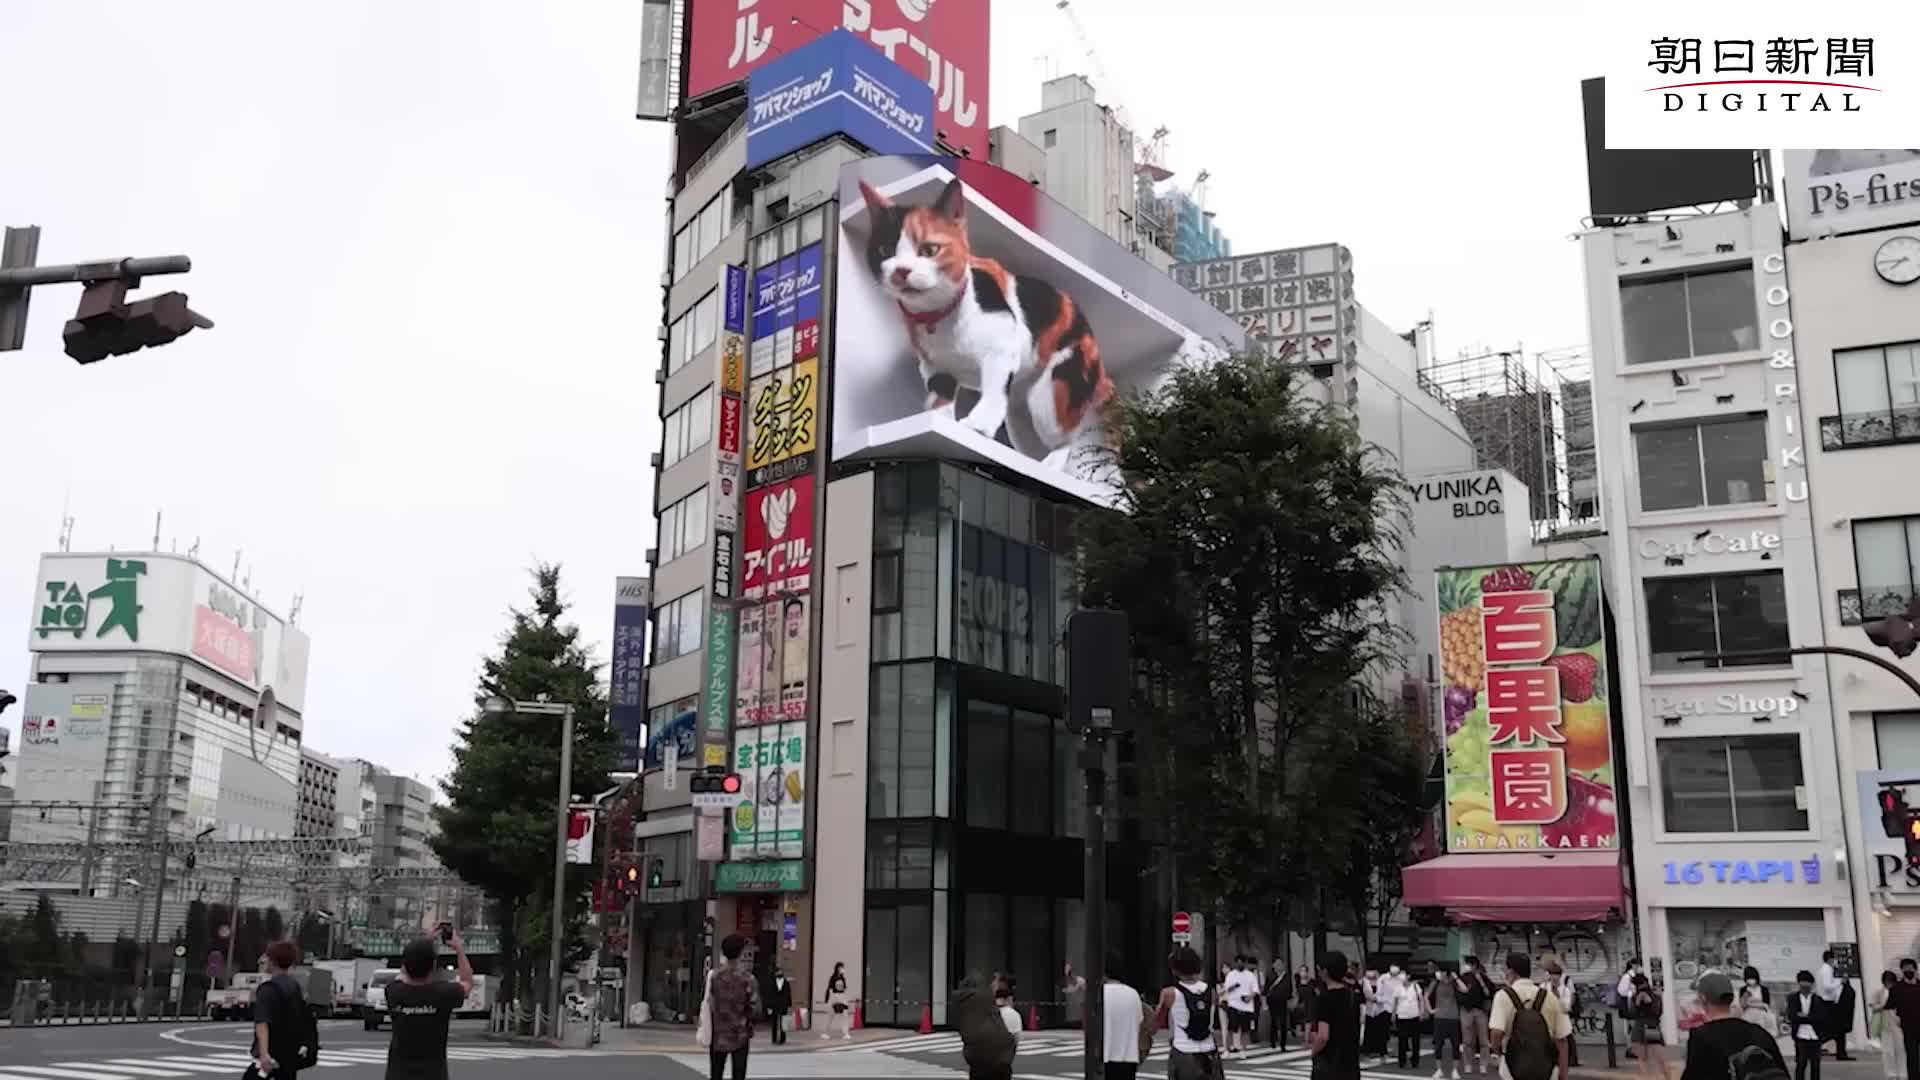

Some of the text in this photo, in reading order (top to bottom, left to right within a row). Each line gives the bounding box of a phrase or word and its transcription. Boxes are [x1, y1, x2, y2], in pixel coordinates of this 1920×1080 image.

[1409, 476, 1502, 503] YUNIKA
[1639, 530, 1782, 560] Cat Cafe
[1480, 589, 1569, 825] 百果園
[1714, 693, 1799, 718] Shop
[738, 736, 801, 769] 宝石広場
[1455, 832, 1610, 849] HYAKKAEN
[1663, 860, 1794, 884] 16 TAPI
